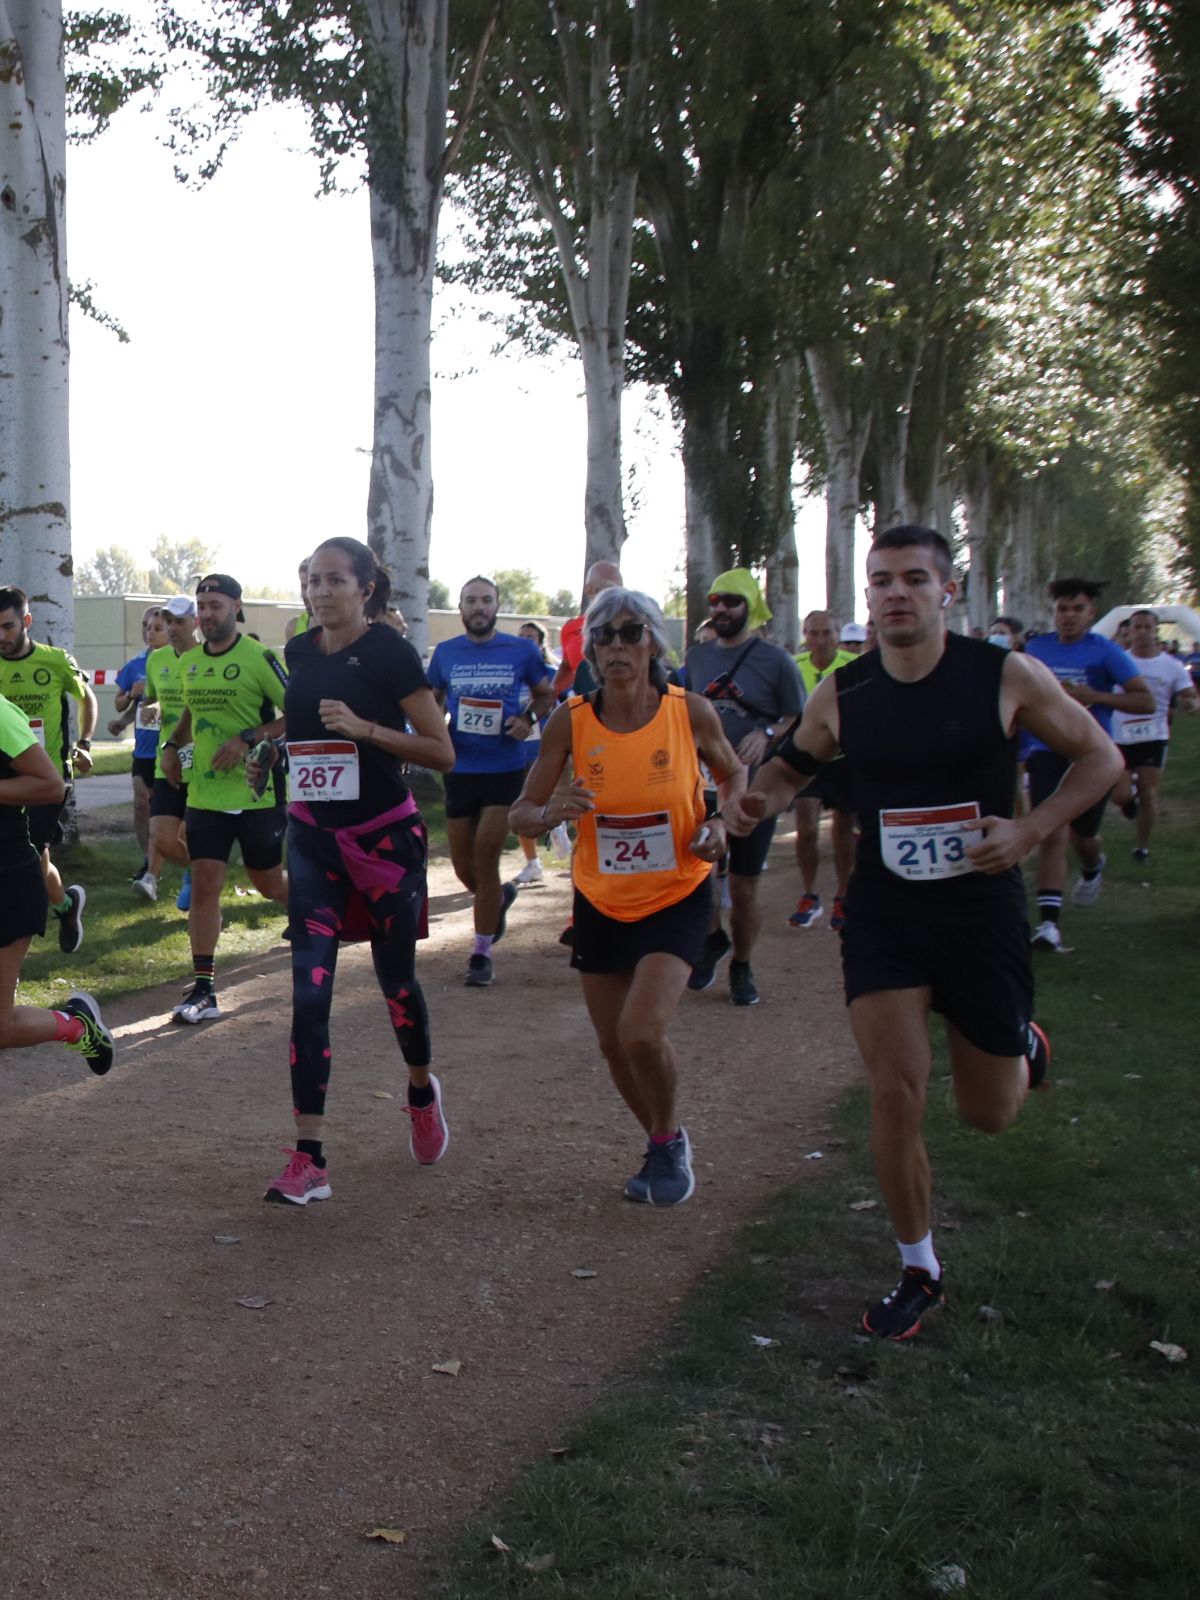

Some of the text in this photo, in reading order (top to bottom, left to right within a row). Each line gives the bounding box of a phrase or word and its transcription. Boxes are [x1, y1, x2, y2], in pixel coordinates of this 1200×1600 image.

[464, 712, 493, 727] 275
[298, 766, 344, 788] 267
[615, 840, 650, 861] 24
[897, 837, 964, 865] 213
